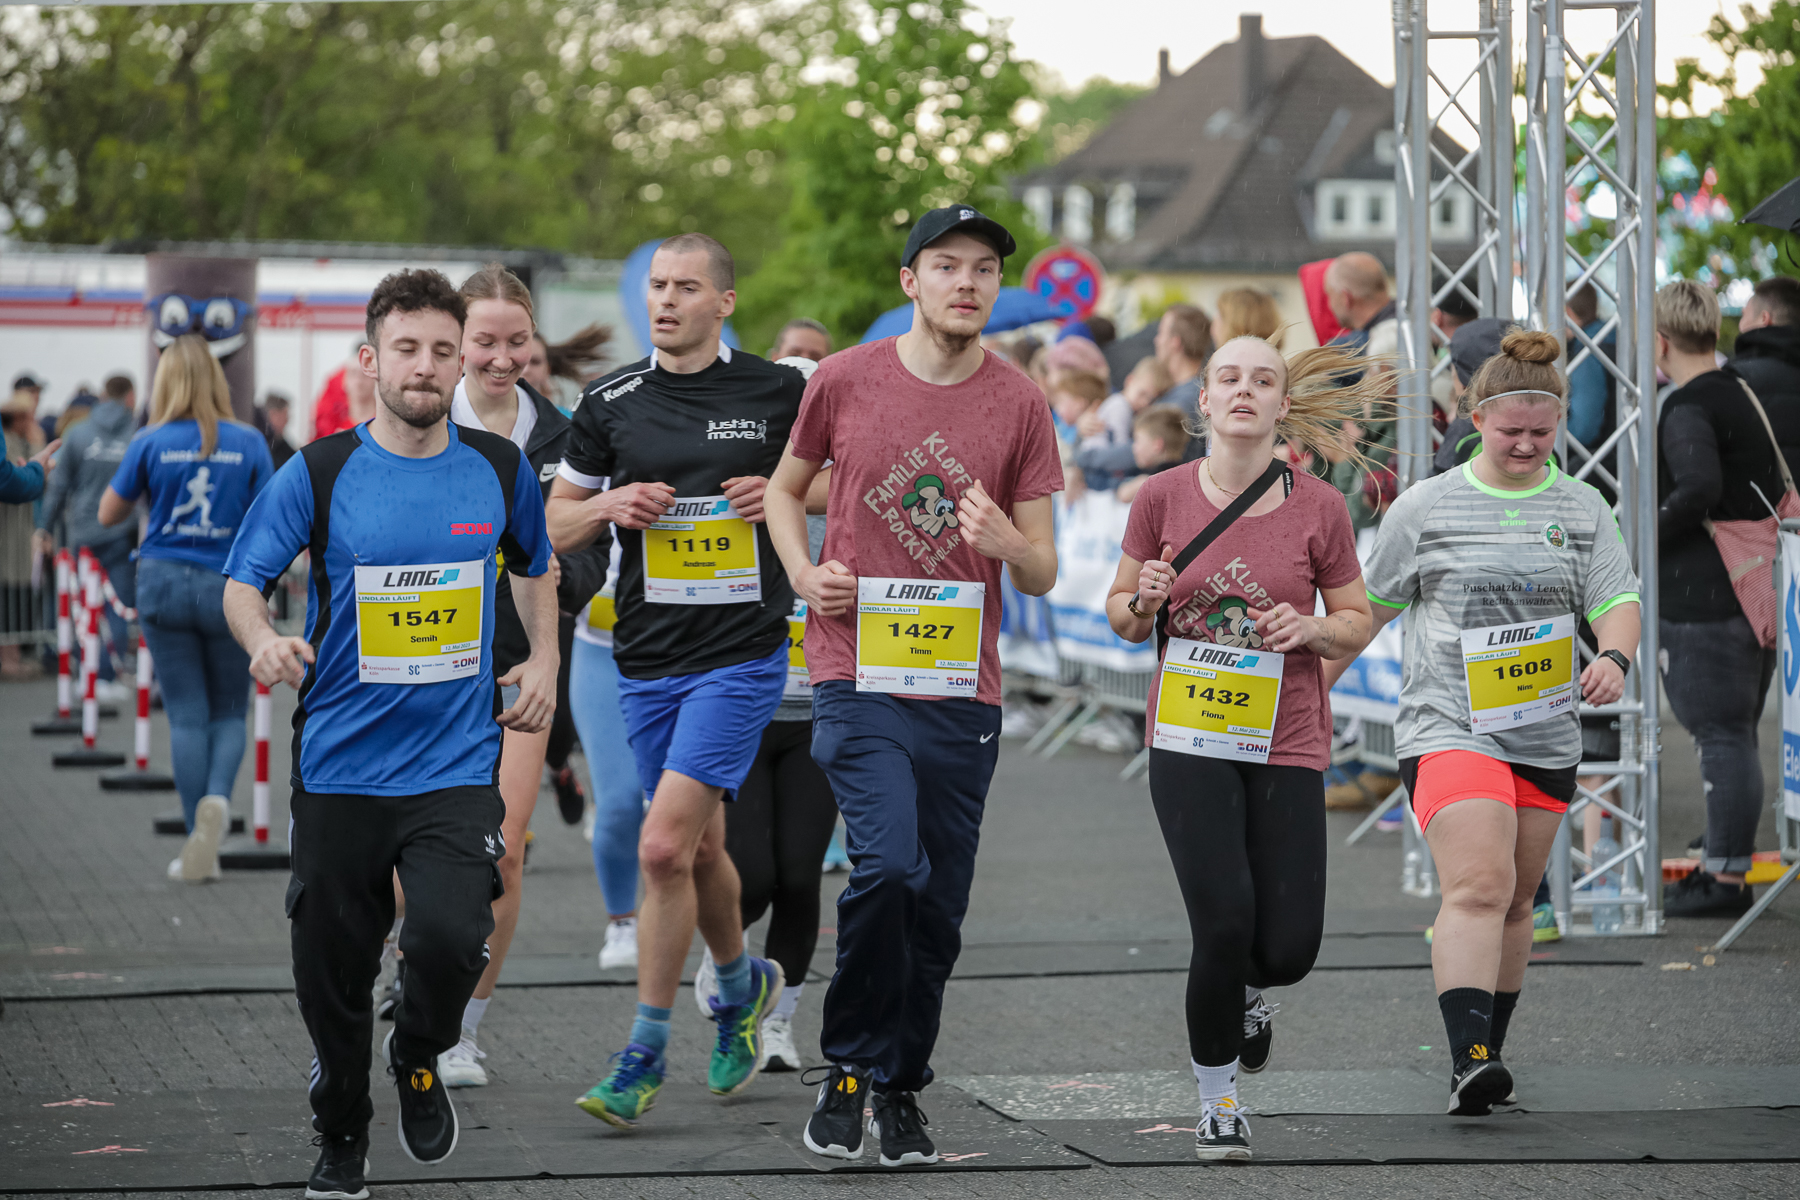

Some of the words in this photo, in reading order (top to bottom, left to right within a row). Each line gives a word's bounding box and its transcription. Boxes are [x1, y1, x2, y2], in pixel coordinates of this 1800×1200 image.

[602, 376, 644, 401] Kempa
[707, 431, 756, 440] move
[543, 463, 561, 474] NIK
[1499, 519, 1527, 527] erima
[882, 506, 932, 561] ROCKT
[668, 537, 730, 552] 1119
[383, 570, 440, 587] LANG
[885, 584, 940, 601] LANG
[1463, 582, 1522, 593] Puschatzki
[1525, 583, 1533, 592] &
[1482, 596, 1552, 606] Rechtsanwälte
[388, 609, 457, 626] 1547
[888, 623, 954, 639] 1427
[1487, 626, 1536, 646] LANG
[410, 635, 438, 643] Semih
[910, 647, 932, 655] Timm
[460, 656, 478, 667] ONI
[1188, 647, 1240, 668] LANG
[408, 665, 420, 675] SC
[1164, 665, 1192, 673] LINDLAR
[1494, 658, 1552, 680] 1608
[904, 675, 915, 686] SC
[956, 677, 975, 687] ONI
[1186, 684, 1250, 707] 1432
[1201, 710, 1225, 720] Fiona
[1513, 710, 1523, 720] SC
[1193, 736, 1204, 748] SC
[1246, 743, 1267, 753] ONI
[1784, 743, 1800, 781] Ele
